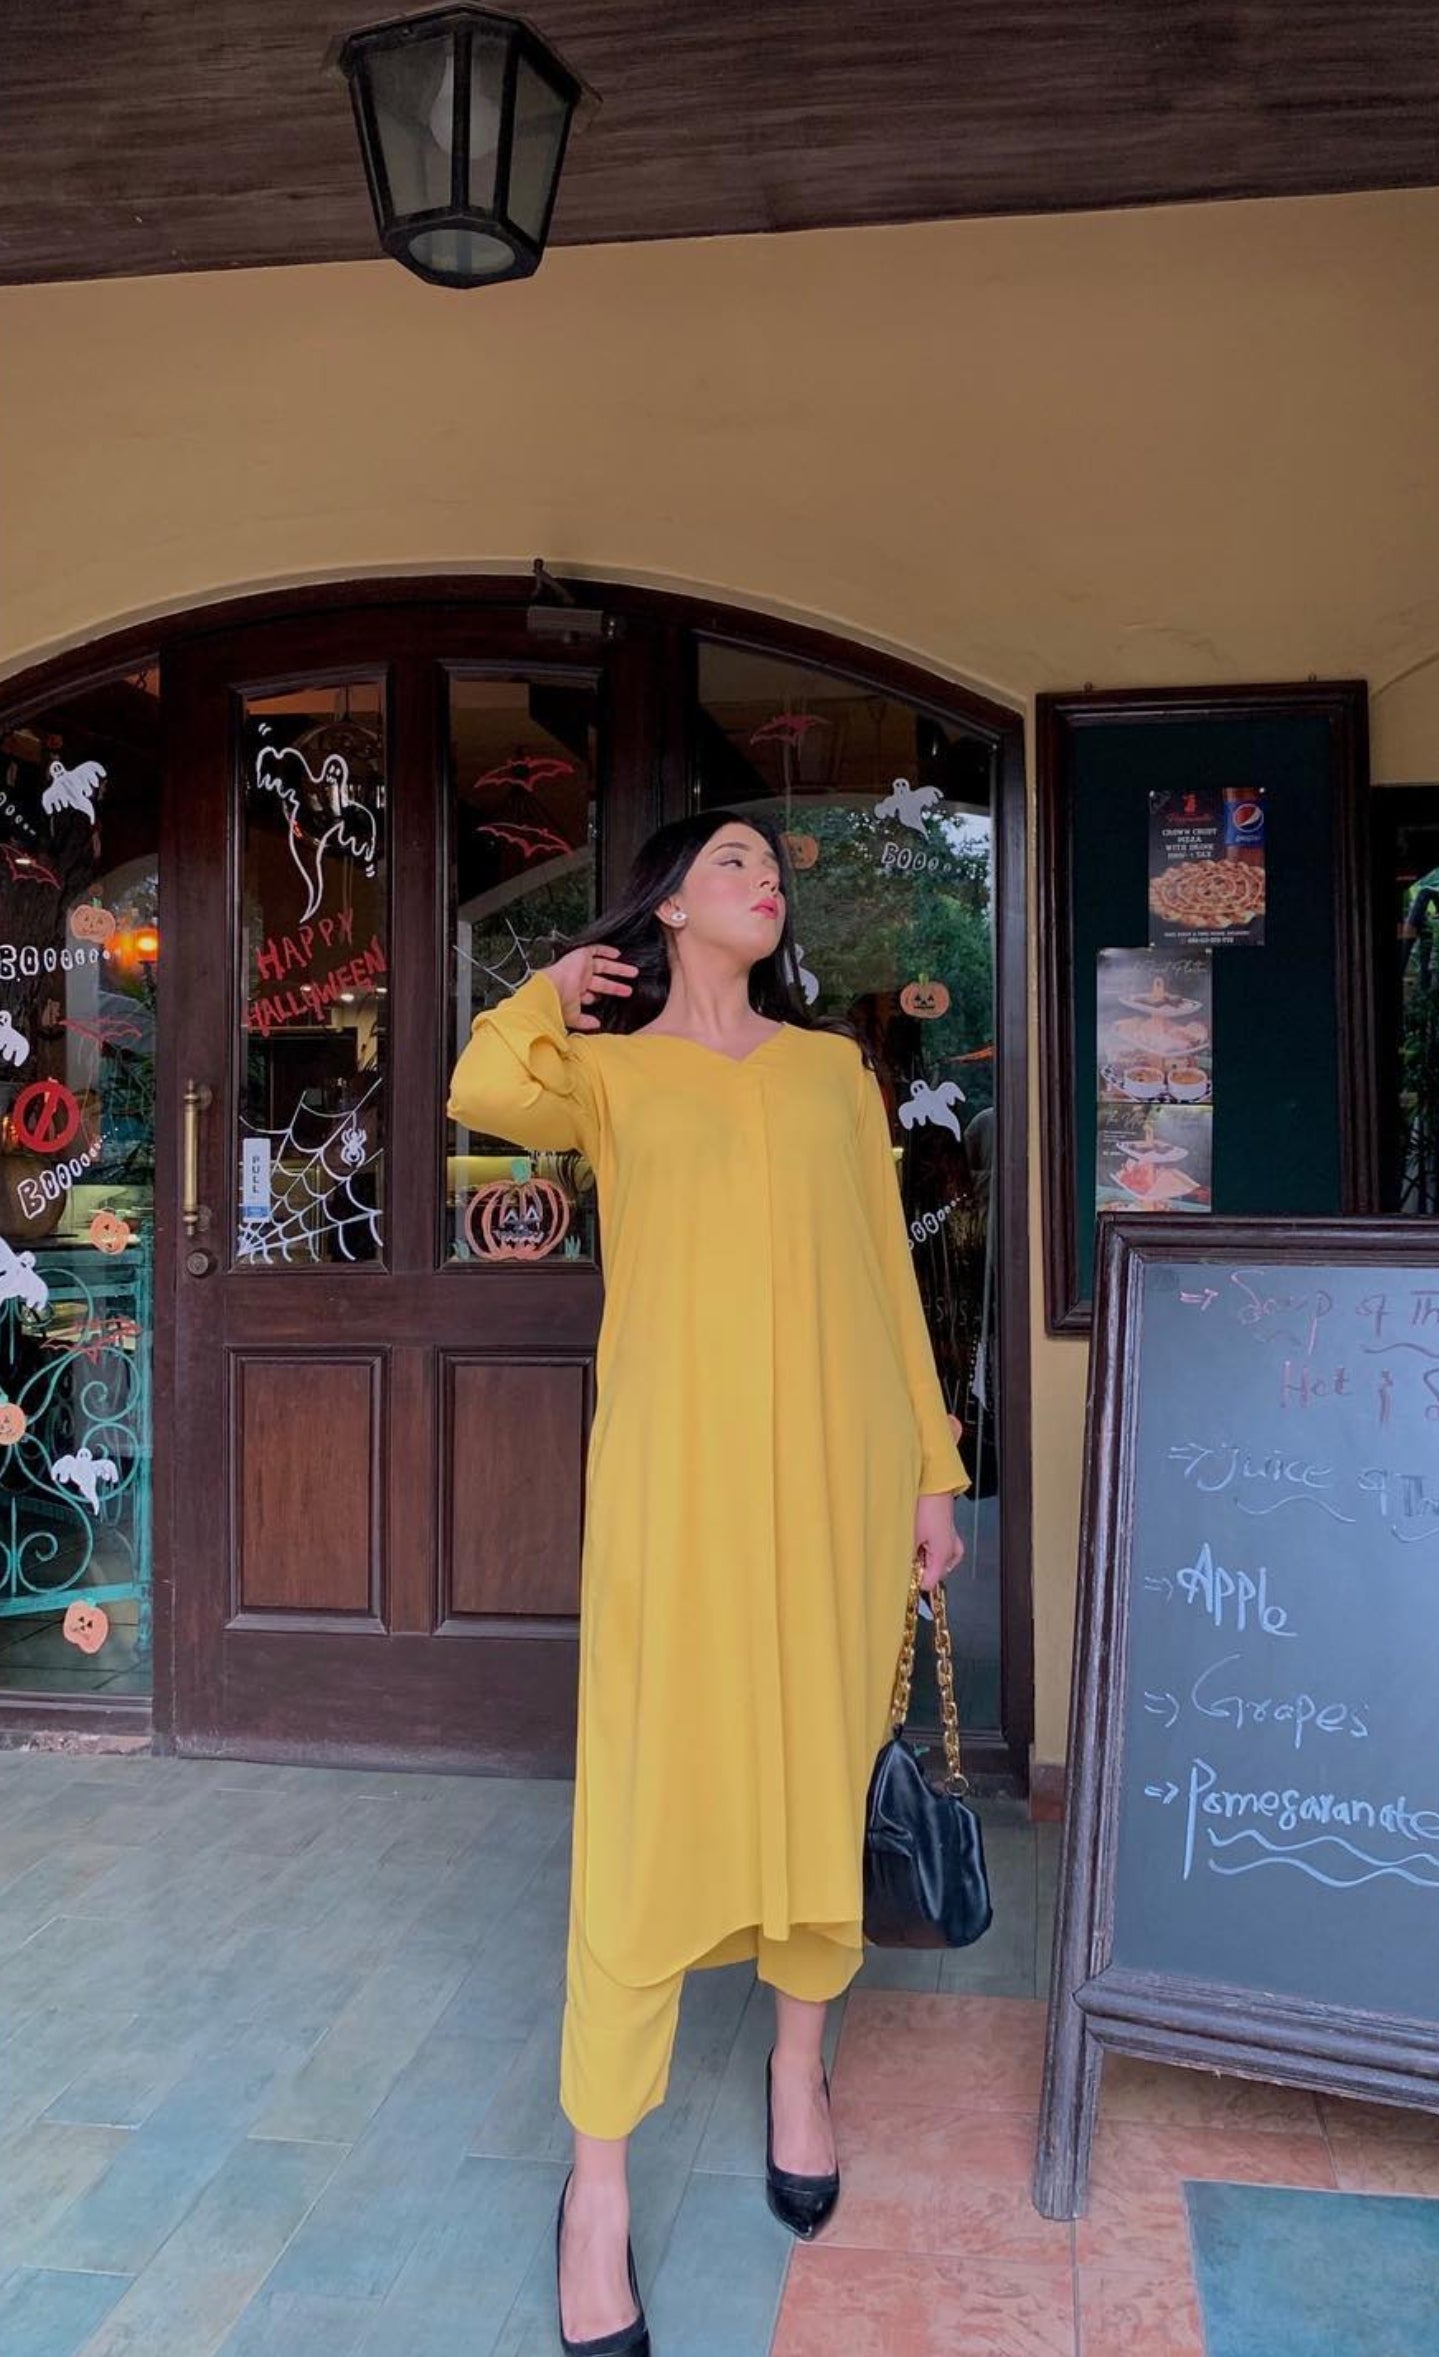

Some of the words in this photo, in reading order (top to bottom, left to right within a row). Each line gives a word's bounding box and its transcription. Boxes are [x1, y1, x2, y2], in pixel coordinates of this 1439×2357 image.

[256, 908, 353, 980] HAPPY
[252, 1155, 260, 1193] PULL
[1197, 1442, 1334, 1491] Juice
[1176, 1542, 1298, 1636] Apple
[1191, 1654, 1369, 1749] Grapes
